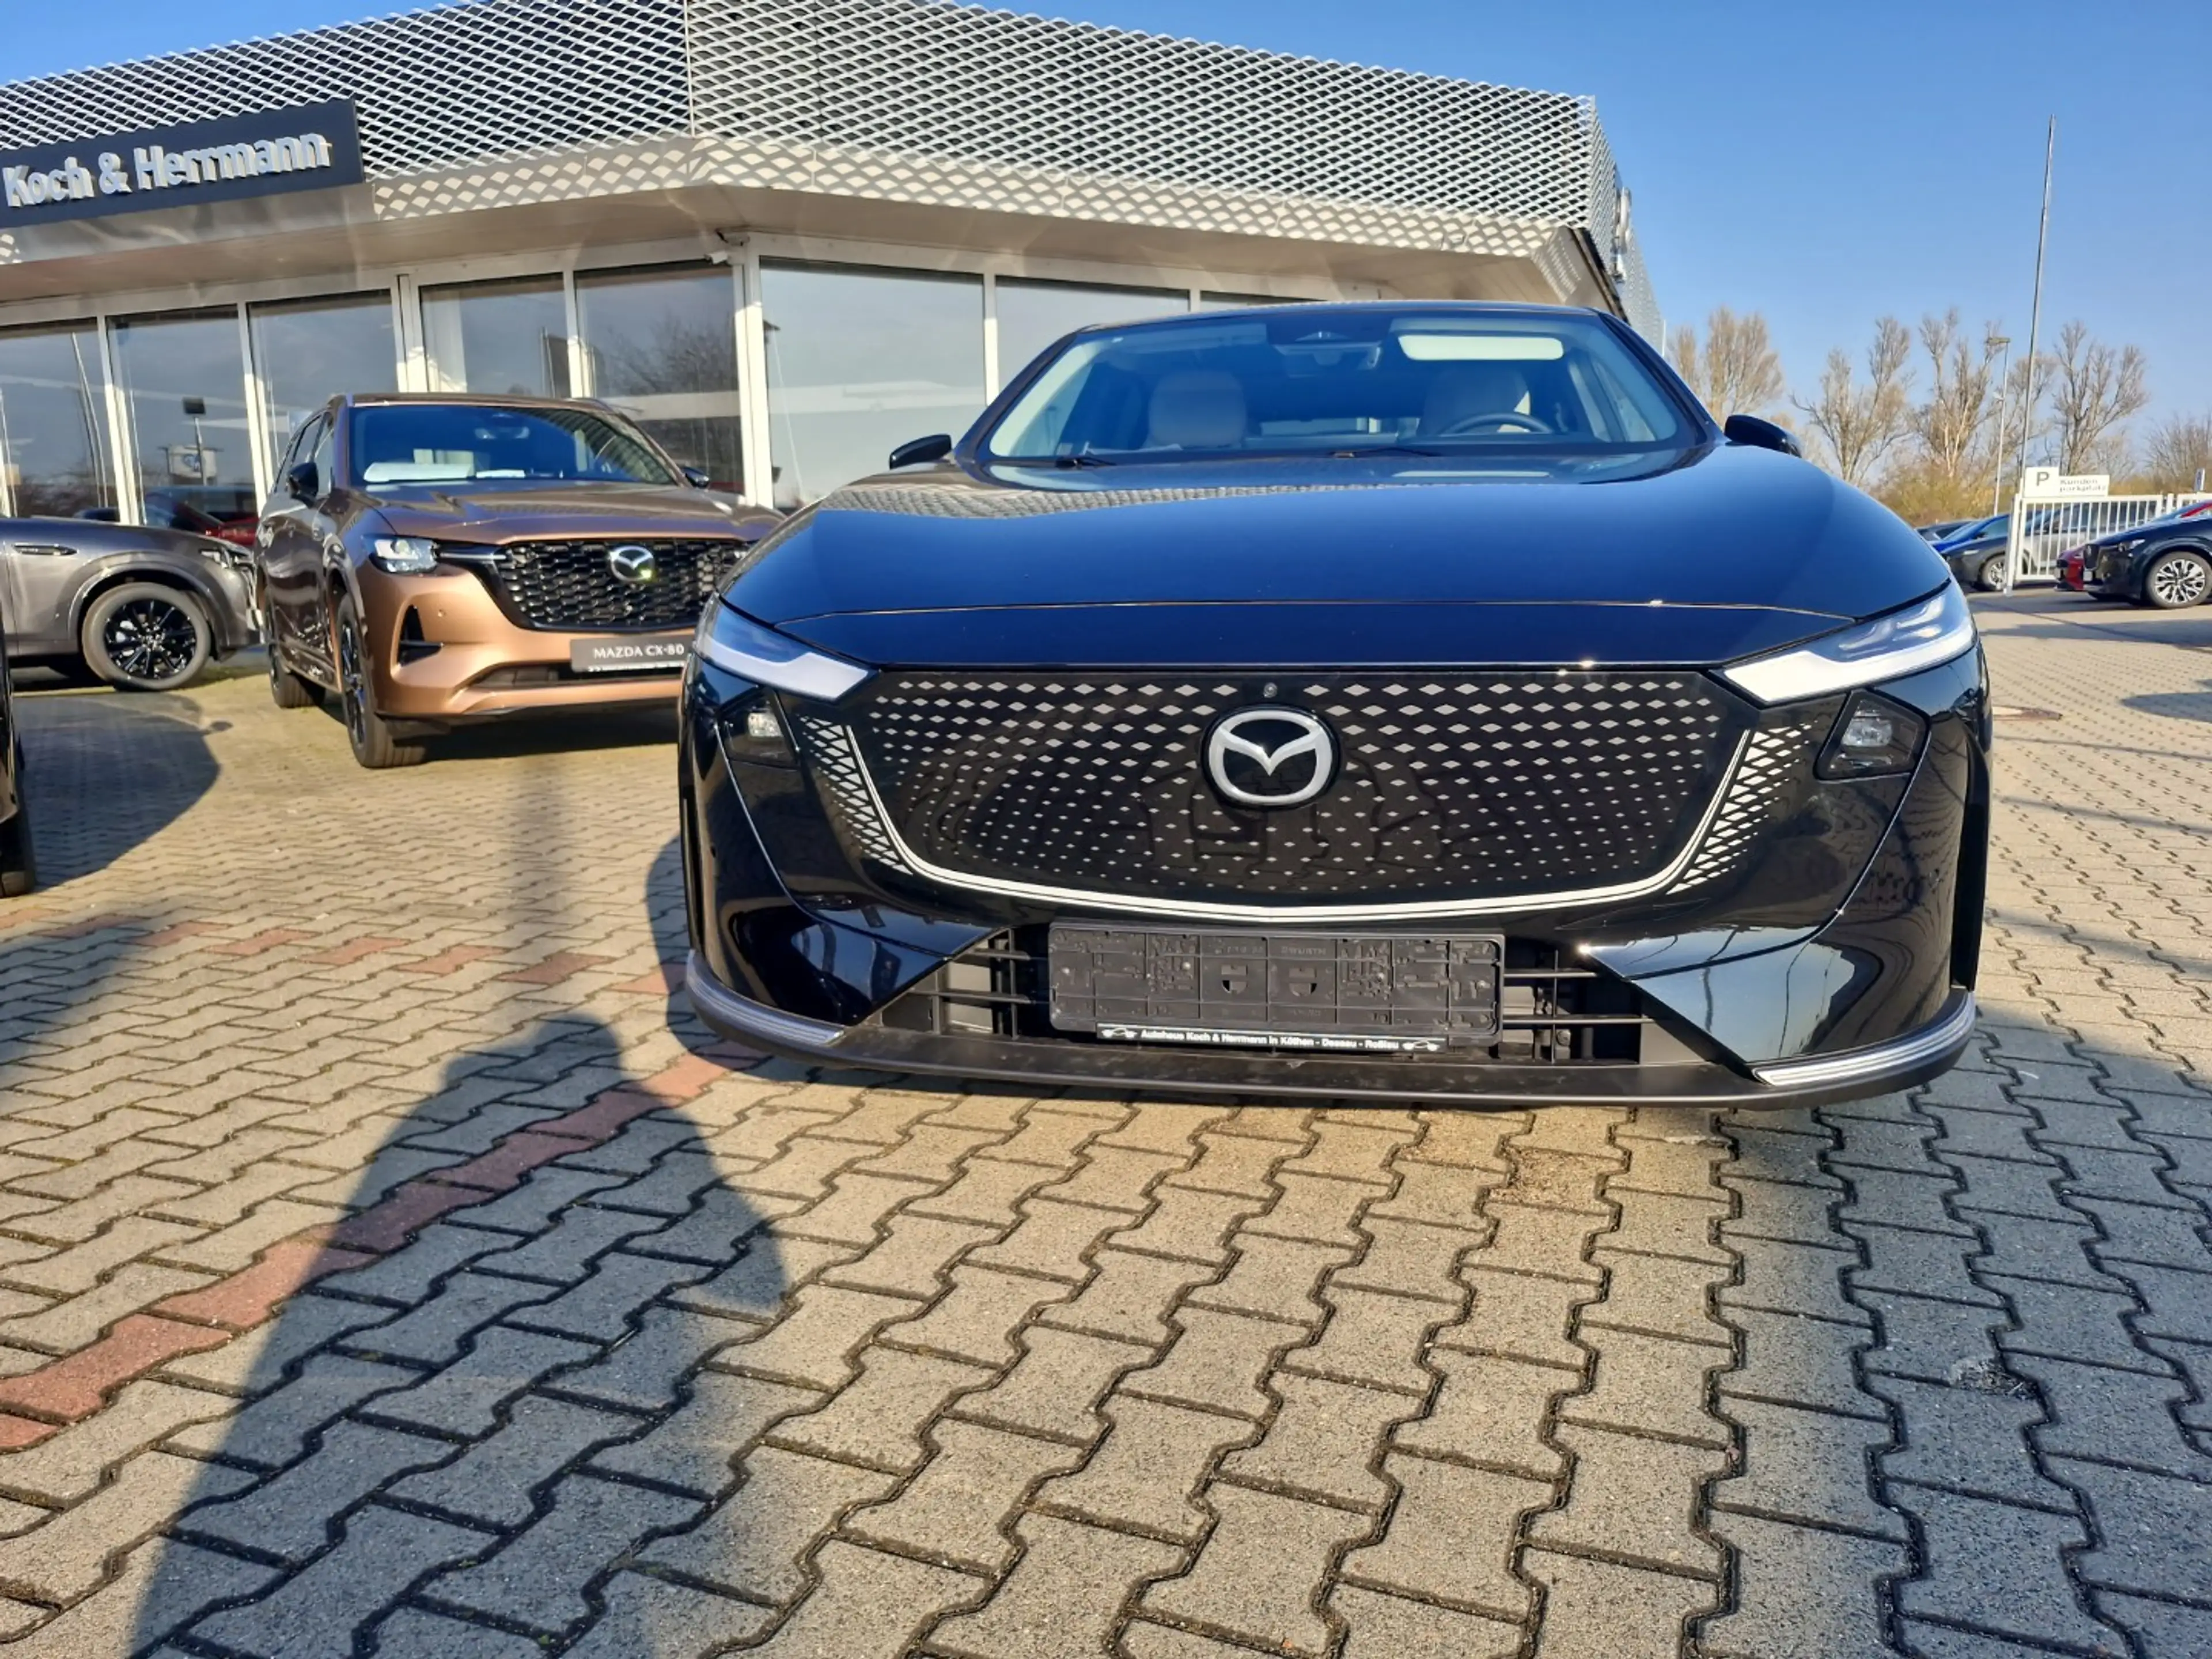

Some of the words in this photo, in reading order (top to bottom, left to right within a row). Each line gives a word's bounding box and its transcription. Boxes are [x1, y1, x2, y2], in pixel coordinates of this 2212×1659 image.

[2, 157, 94, 207] Koch
[98, 152, 131, 195] &
[134, 133, 332, 190] Herrmann
[2036, 471, 2050, 487] P
[593, 646, 643, 659] MAZDA
[646, 643, 685, 657] CX-80
[1141, 1029, 1184, 1040] Autohaus
[1185, 1032, 1211, 1041] Koch
[1212, 1033, 1220, 1042] &
[1221, 1033, 1267, 1044] Herrmann
[1280, 1036, 1314, 1046] Köthen
[1321, 1038, 1357, 1048] Dessau
